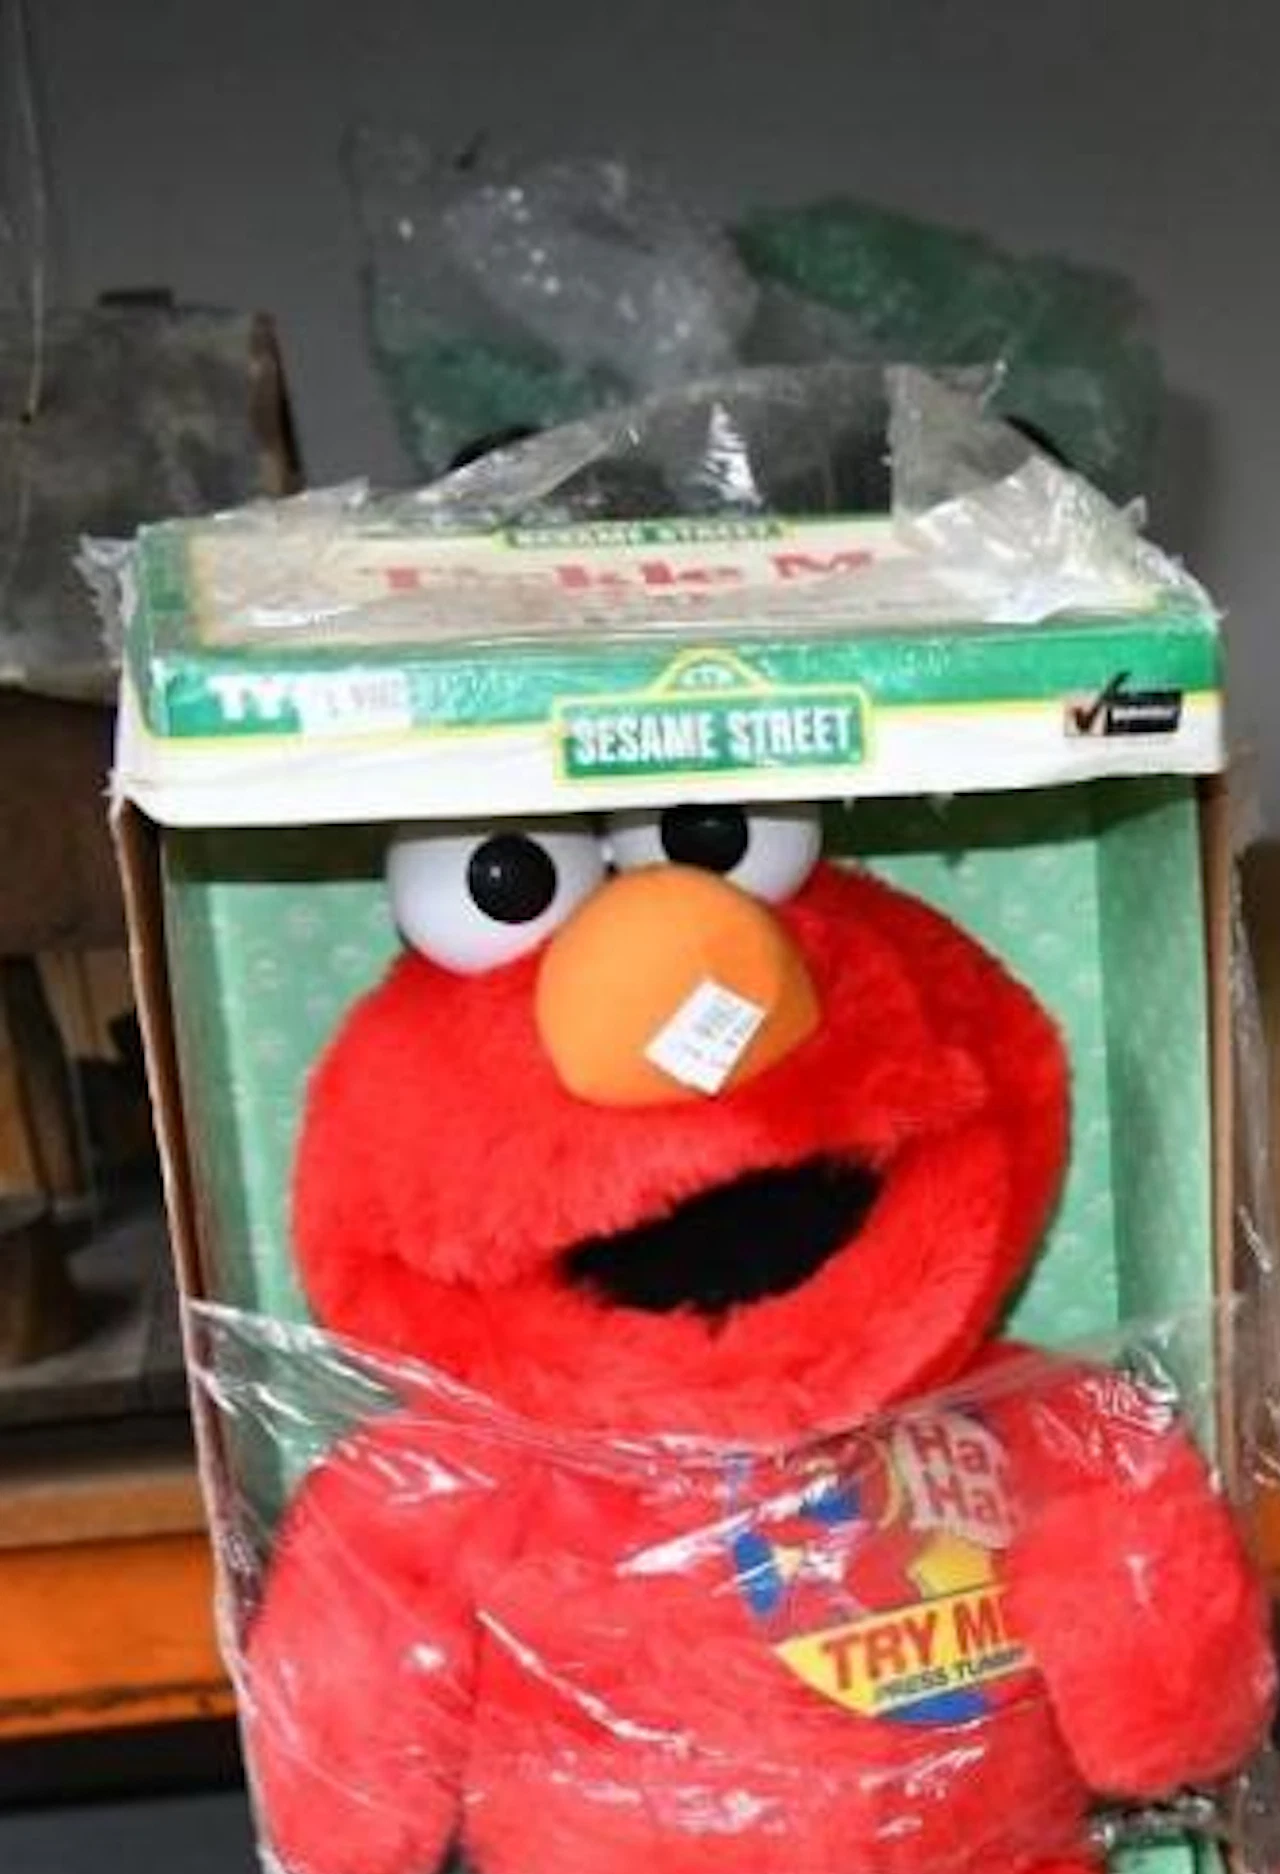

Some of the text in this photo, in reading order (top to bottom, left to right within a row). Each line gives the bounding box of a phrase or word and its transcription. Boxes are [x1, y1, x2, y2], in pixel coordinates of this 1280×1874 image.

[573, 705, 853, 767] SESAME STREET
[822, 1596, 1001, 1690] TRY M
